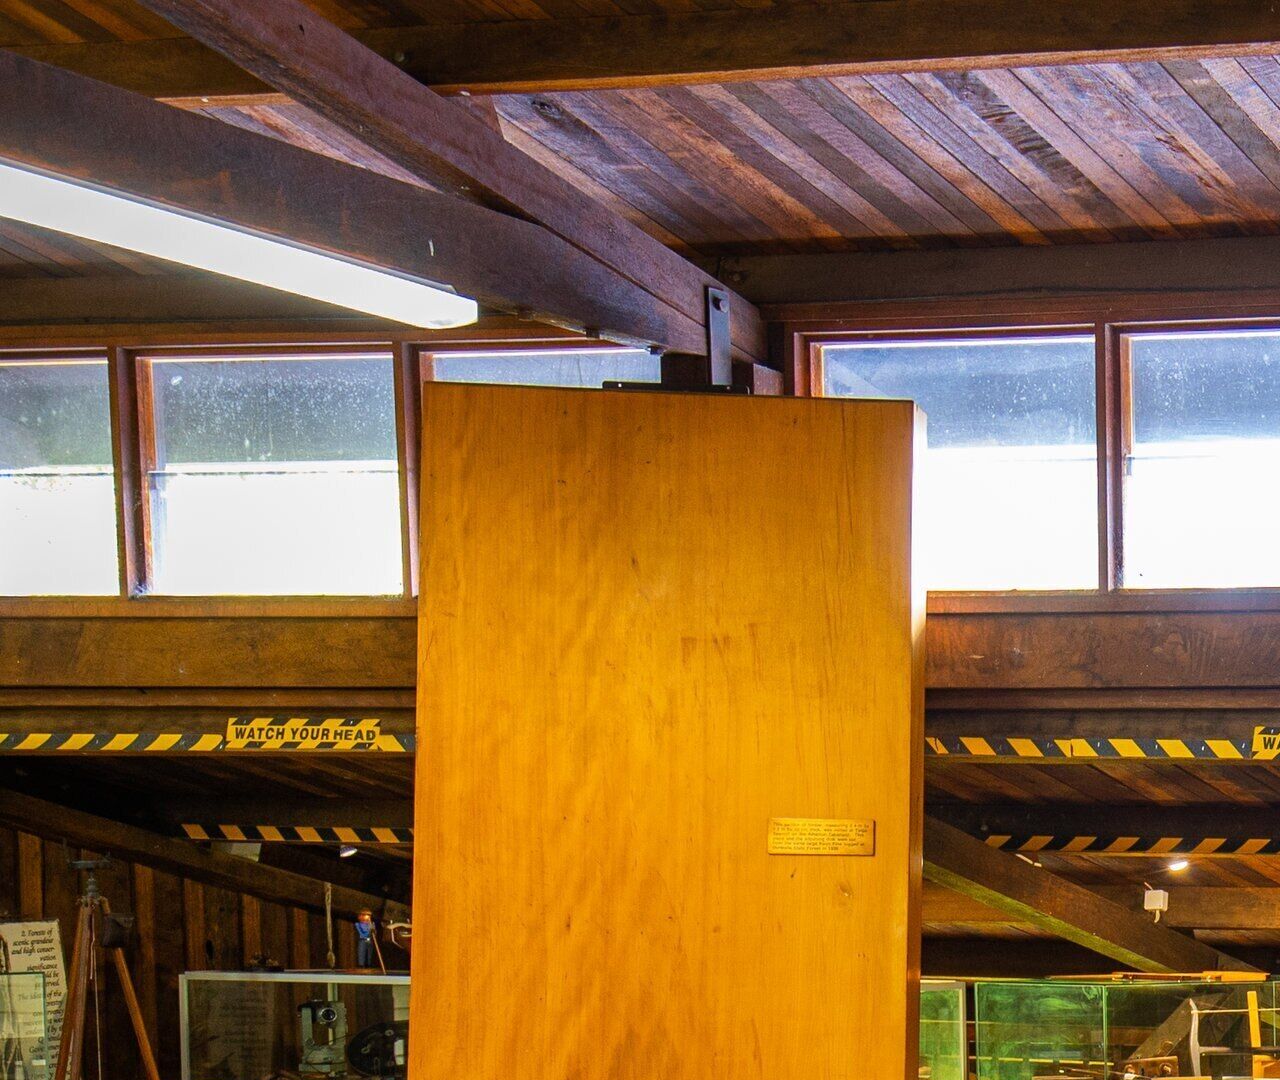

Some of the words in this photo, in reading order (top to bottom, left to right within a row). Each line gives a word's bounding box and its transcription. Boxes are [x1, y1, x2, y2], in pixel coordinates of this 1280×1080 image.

[235, 727, 285, 739] WATCH
[291, 728, 330, 740] YOUR
[333, 729, 376, 740] HEAD
